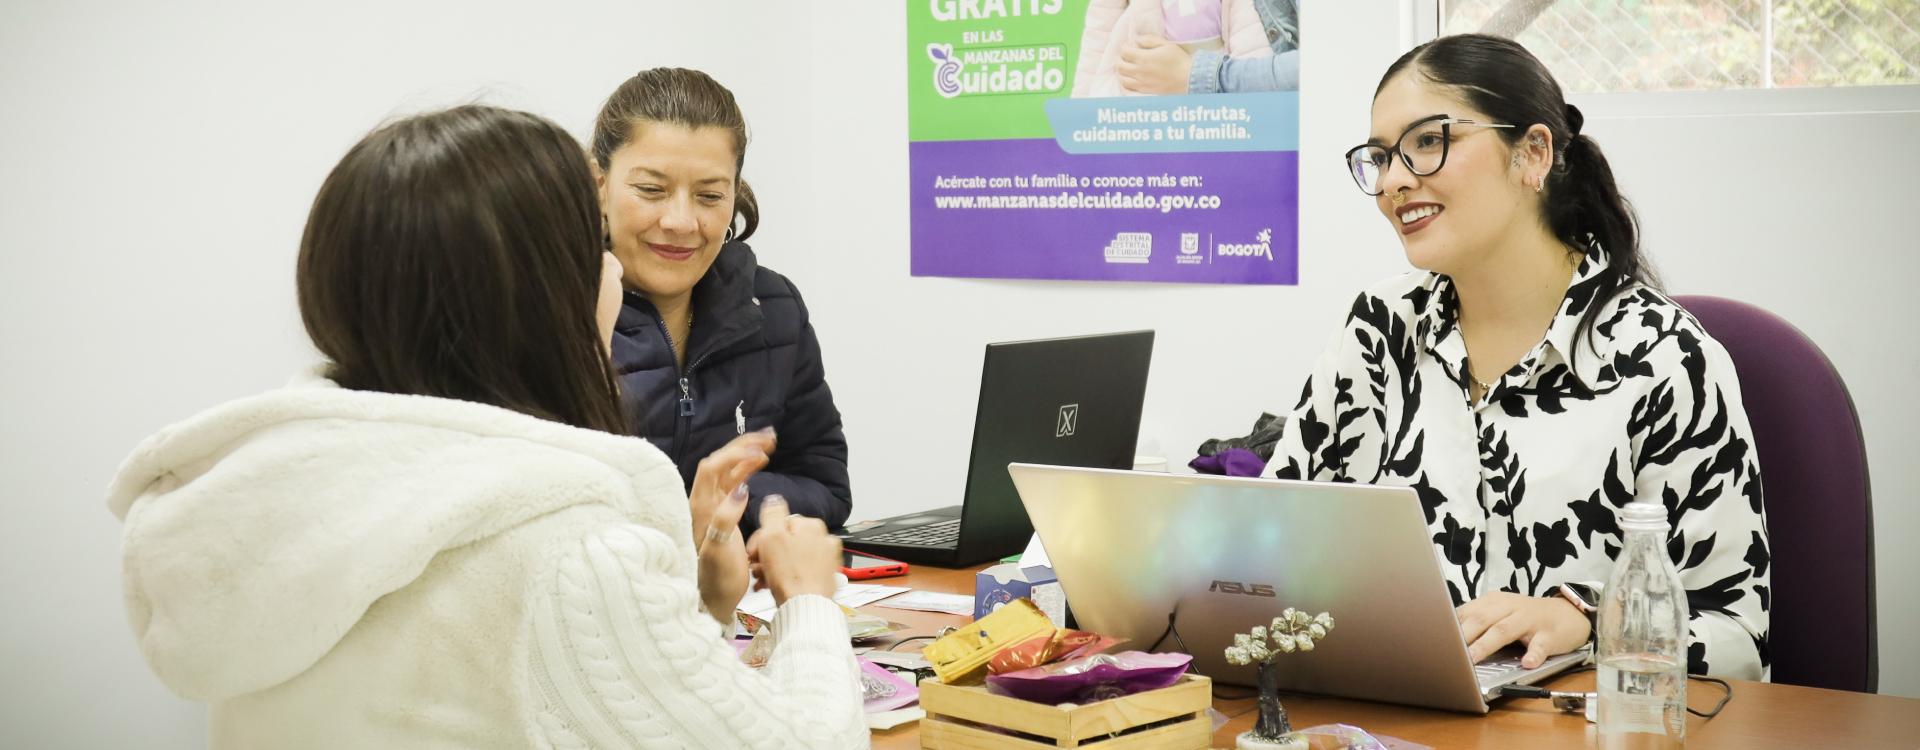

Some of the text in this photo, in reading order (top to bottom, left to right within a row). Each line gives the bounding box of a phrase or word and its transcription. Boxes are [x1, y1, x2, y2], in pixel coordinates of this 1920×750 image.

[930, 0, 1063, 21] GRATIS
[963, 30, 1004, 44] EN LAS
[964, 46, 1063, 64] MANZANAS DEL
[936, 62, 1064, 95] Cuidado
[1097, 105, 1251, 124] Mientras disfrutas,
[1073, 123, 1251, 142] cuidamos a tu familia.
[935, 172, 1203, 189] Acércate con tu familia o conoce más en:
[935, 191, 1222, 213] www.manzanasdelcuidado.gov.co
[1208, 580, 1277, 598] ASUS
